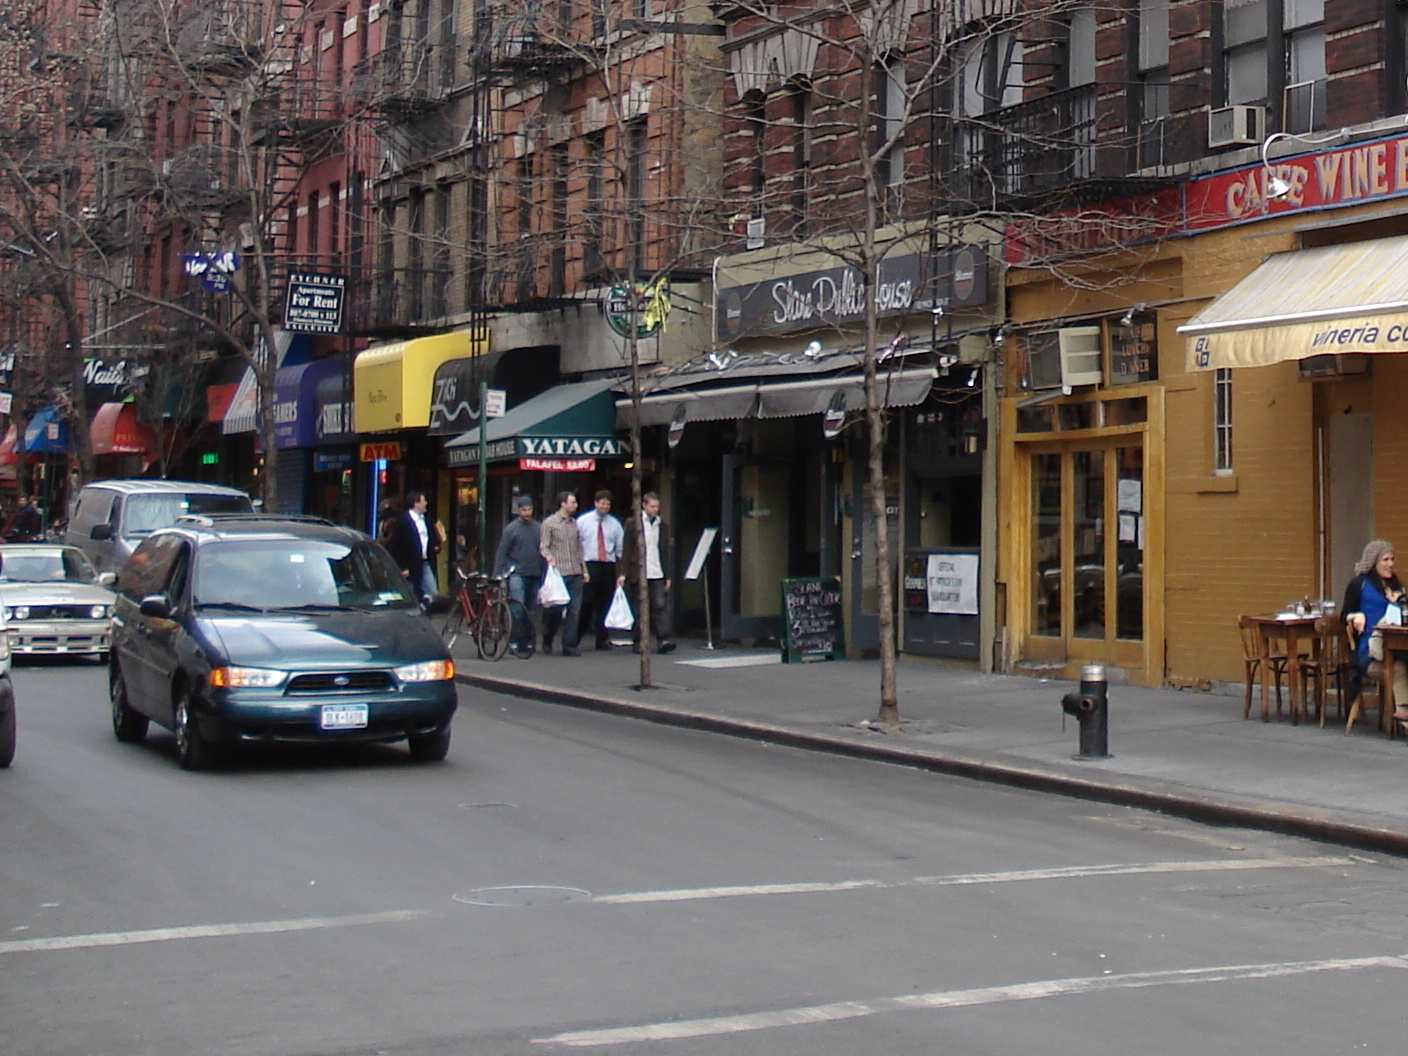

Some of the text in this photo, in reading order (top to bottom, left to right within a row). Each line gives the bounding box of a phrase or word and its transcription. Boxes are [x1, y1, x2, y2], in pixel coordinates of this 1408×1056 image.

[1315, 144, 1389, 202] WINE
[292, 293, 338, 309] For Rent
[1312, 322, 1380, 347] vineria
[83, 360, 126, 385] Nails
[363, 445, 398, 461] ATM
[522, 437, 631, 456] YATAGAN
[526, 459, 563, 469] FALAFEL
